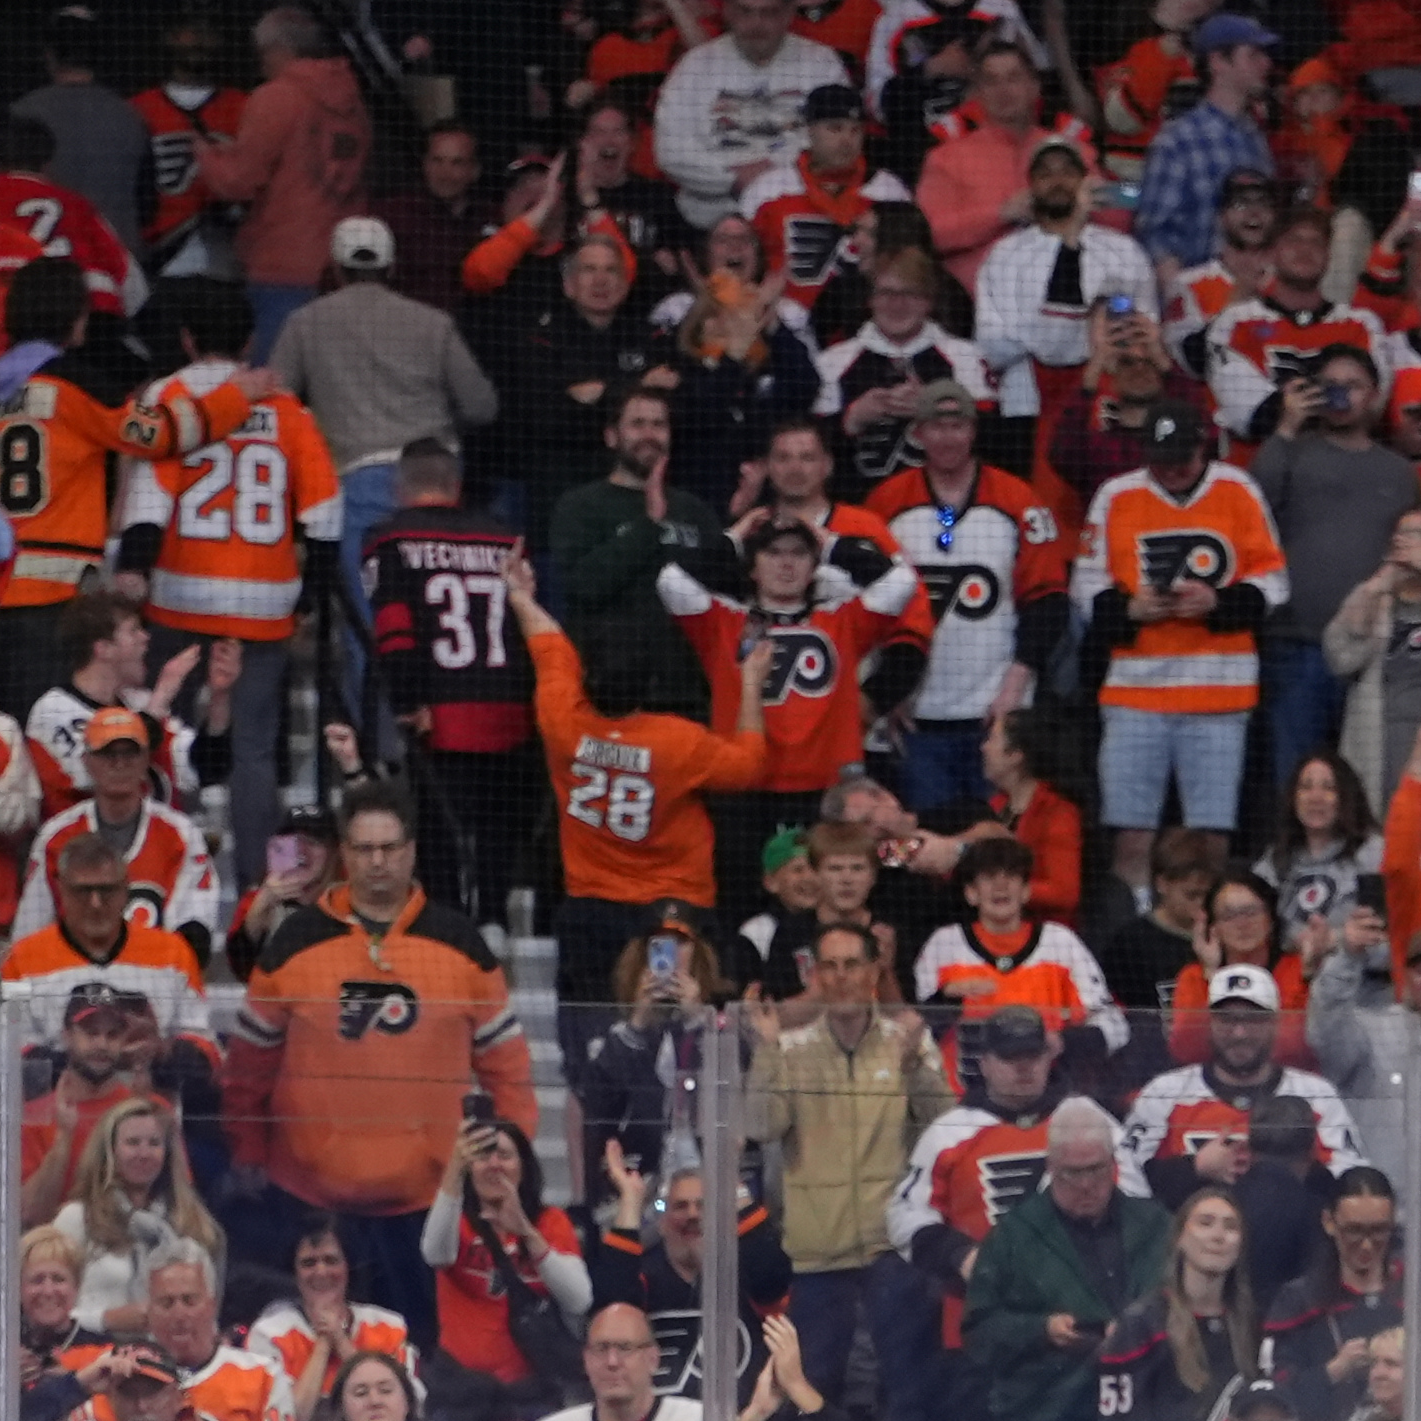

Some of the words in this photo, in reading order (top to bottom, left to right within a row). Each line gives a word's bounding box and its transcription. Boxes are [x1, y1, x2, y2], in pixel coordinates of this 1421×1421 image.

[178, 441, 286, 544] 28
[425, 572, 509, 668] 37
[567, 761, 655, 842] 28
